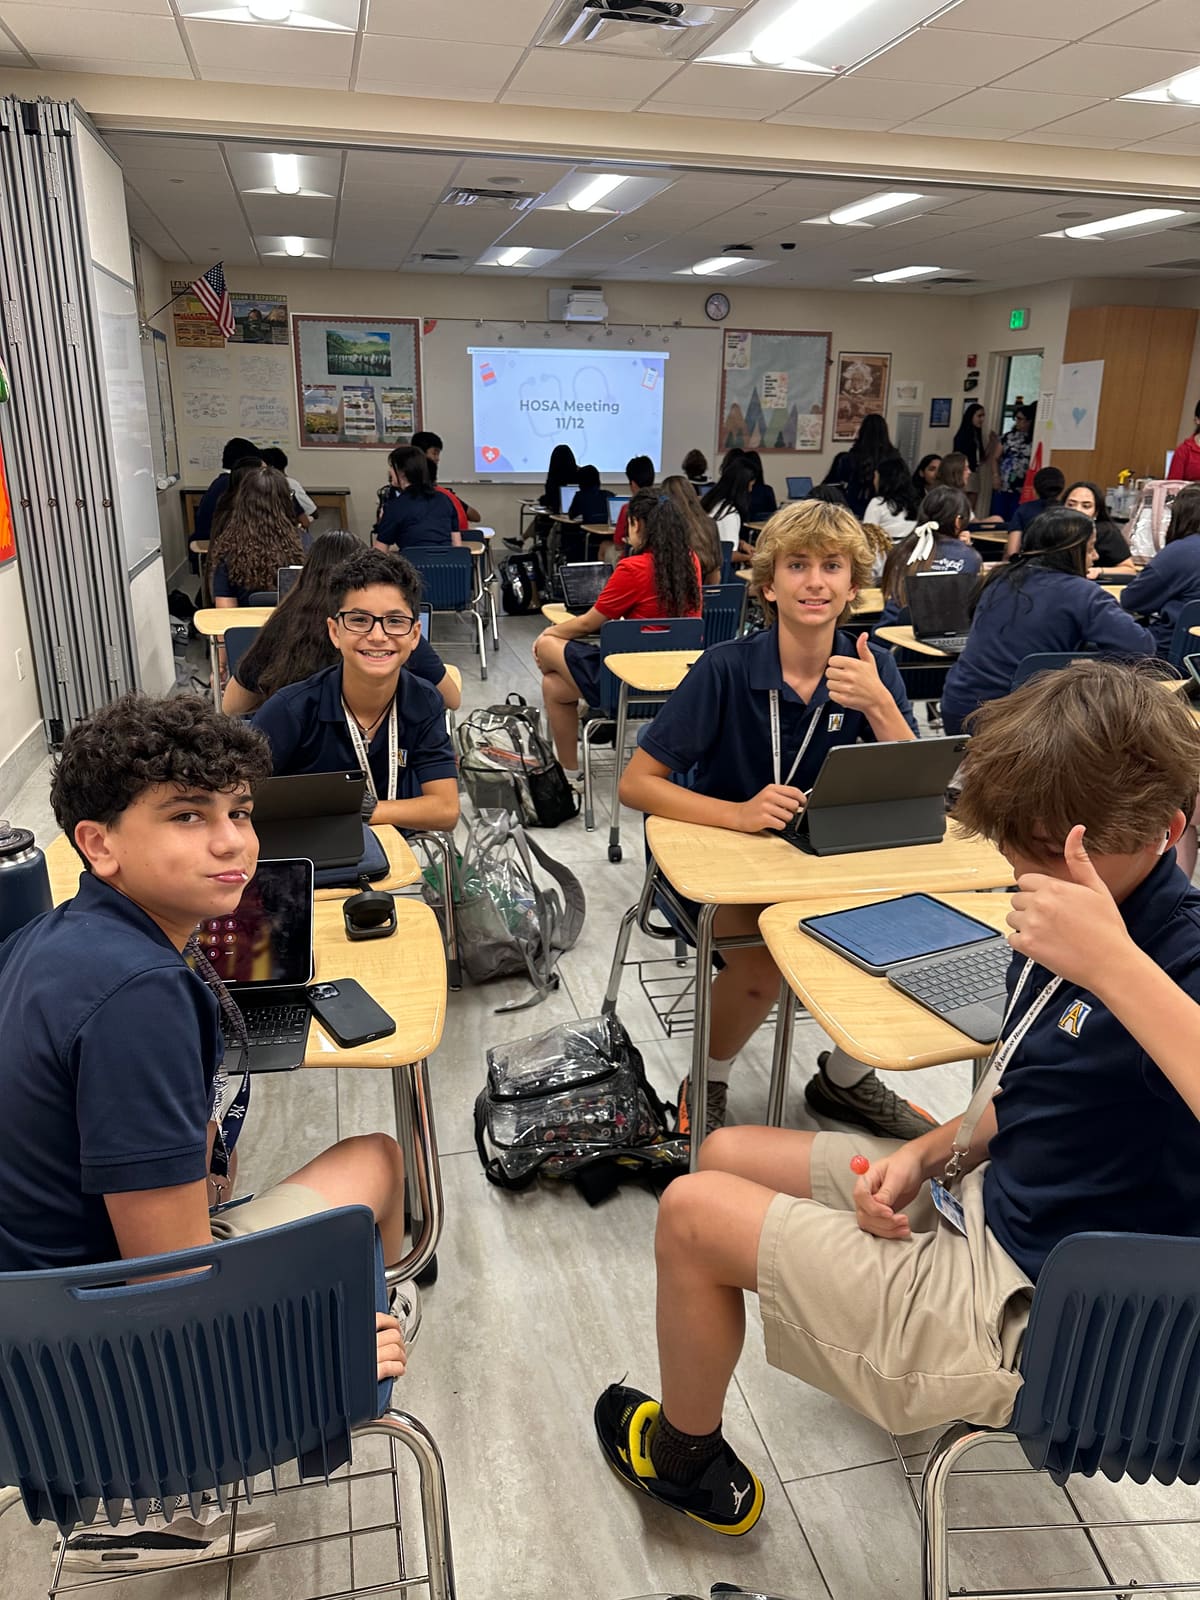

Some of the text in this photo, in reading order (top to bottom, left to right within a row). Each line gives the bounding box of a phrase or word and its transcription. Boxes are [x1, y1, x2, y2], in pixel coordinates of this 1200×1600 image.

[520, 399, 620, 415] HOSA Meeting
[555, 416, 585, 430] 11/12
